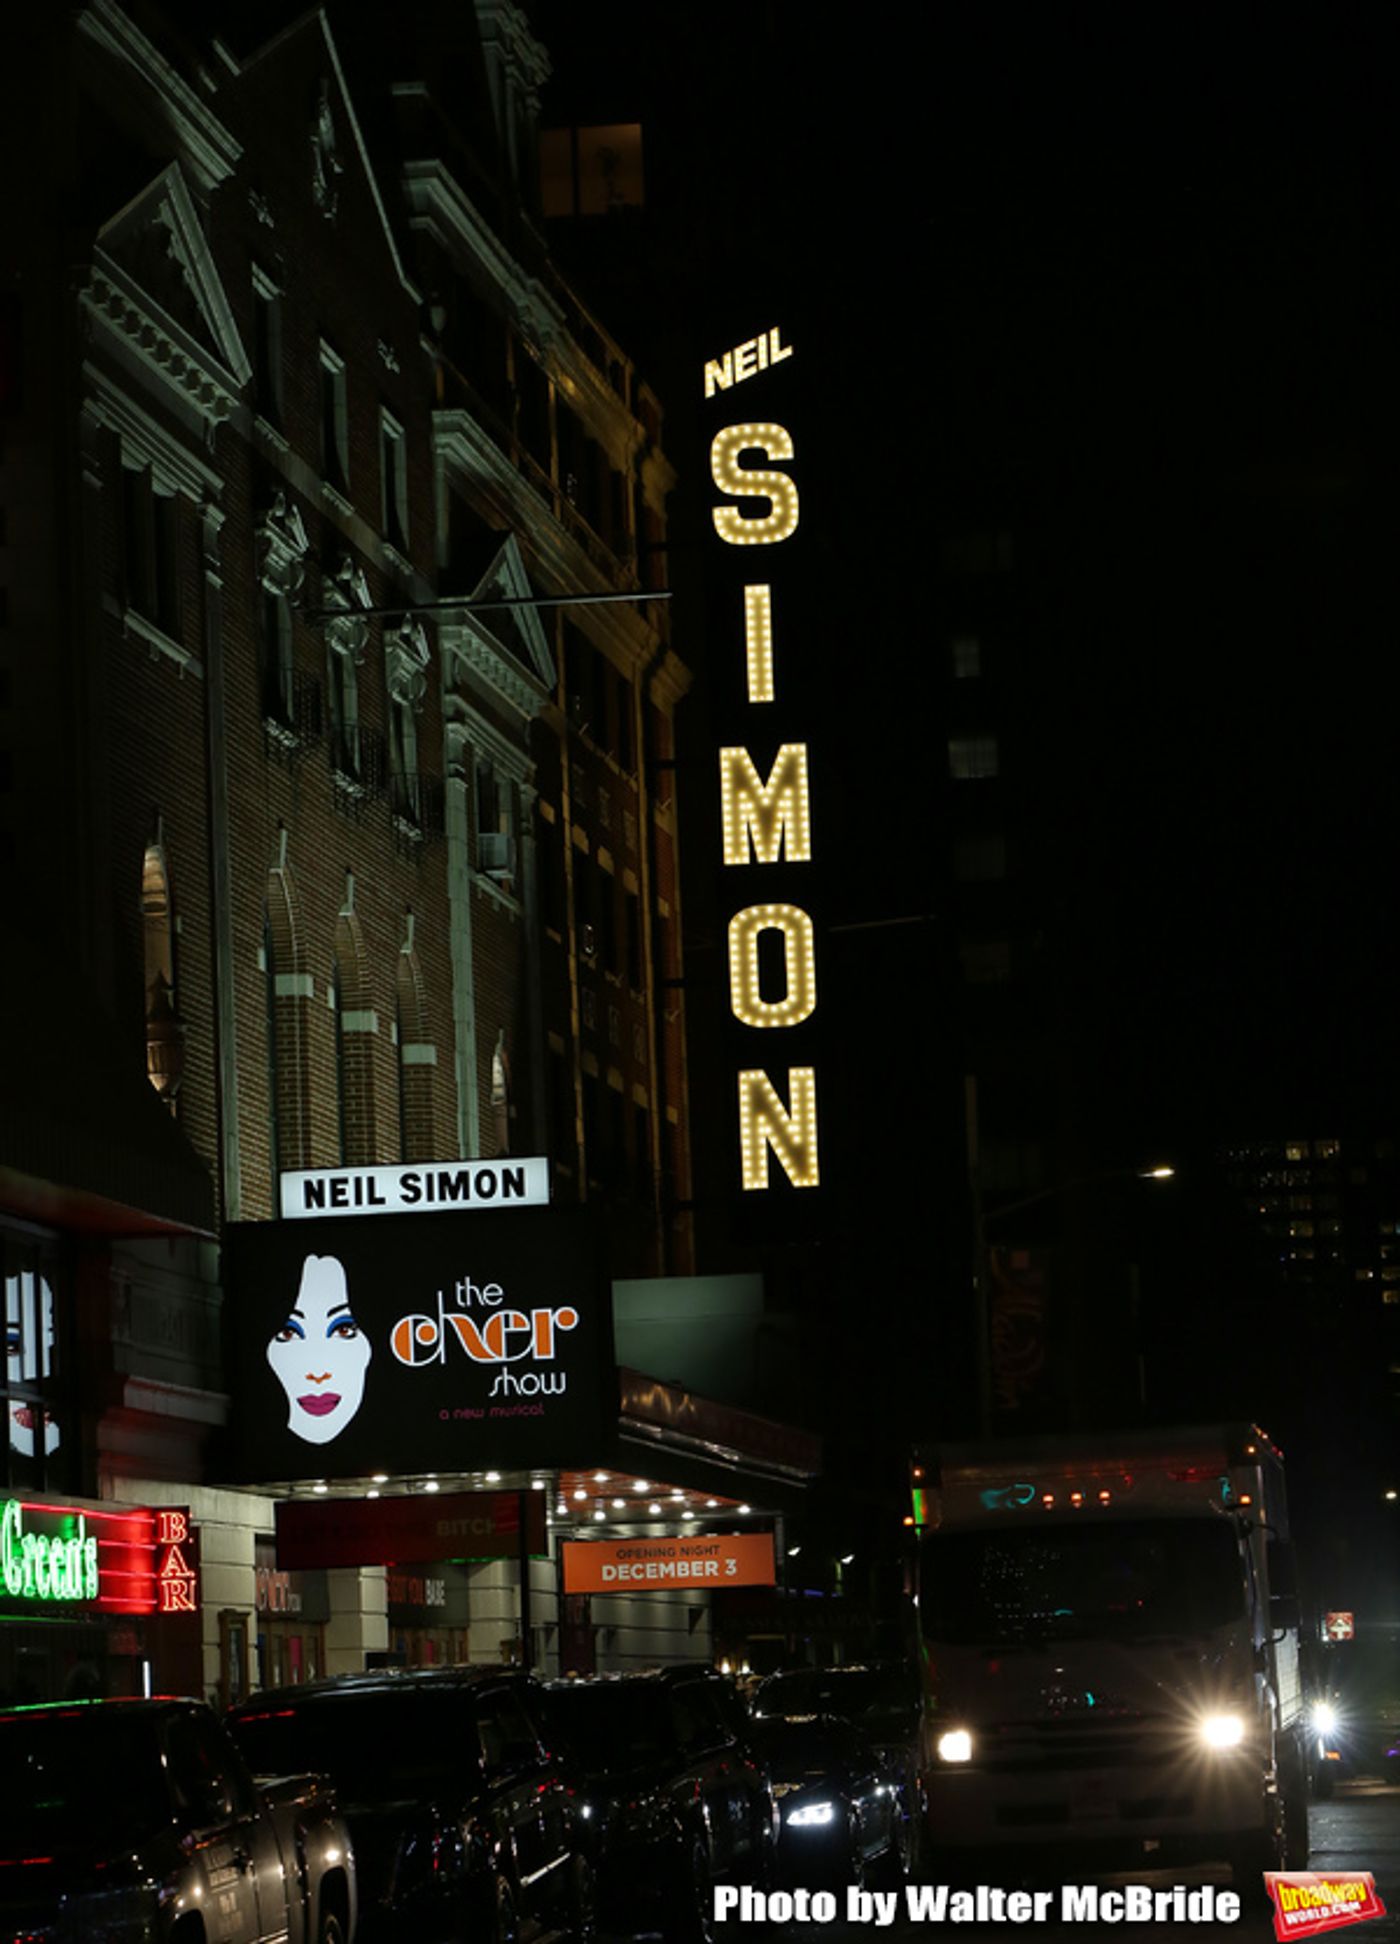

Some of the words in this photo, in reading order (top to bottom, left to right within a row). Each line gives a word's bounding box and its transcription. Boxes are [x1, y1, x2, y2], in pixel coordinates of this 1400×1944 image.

[704, 326, 793, 398] NEIL
[711, 421, 821, 1191] SIMON
[304, 1177, 387, 1209] NEIL
[400, 1167, 526, 1204] SIMON
[455, 1276, 504, 1307] the
[390, 1290, 580, 1367] cher
[488, 1366, 567, 1397] show
[439, 1409, 450, 1420] a
[453, 1407, 485, 1419] new
[489, 1402, 545, 1417] musical
[160, 1511, 197, 1612] BAR
[602, 1560, 719, 1581] DECEMBER
[725, 1558, 737, 1576] 3
[616, 1547, 676, 1560] OPENING
[680, 1544, 720, 1557] NIGHT
